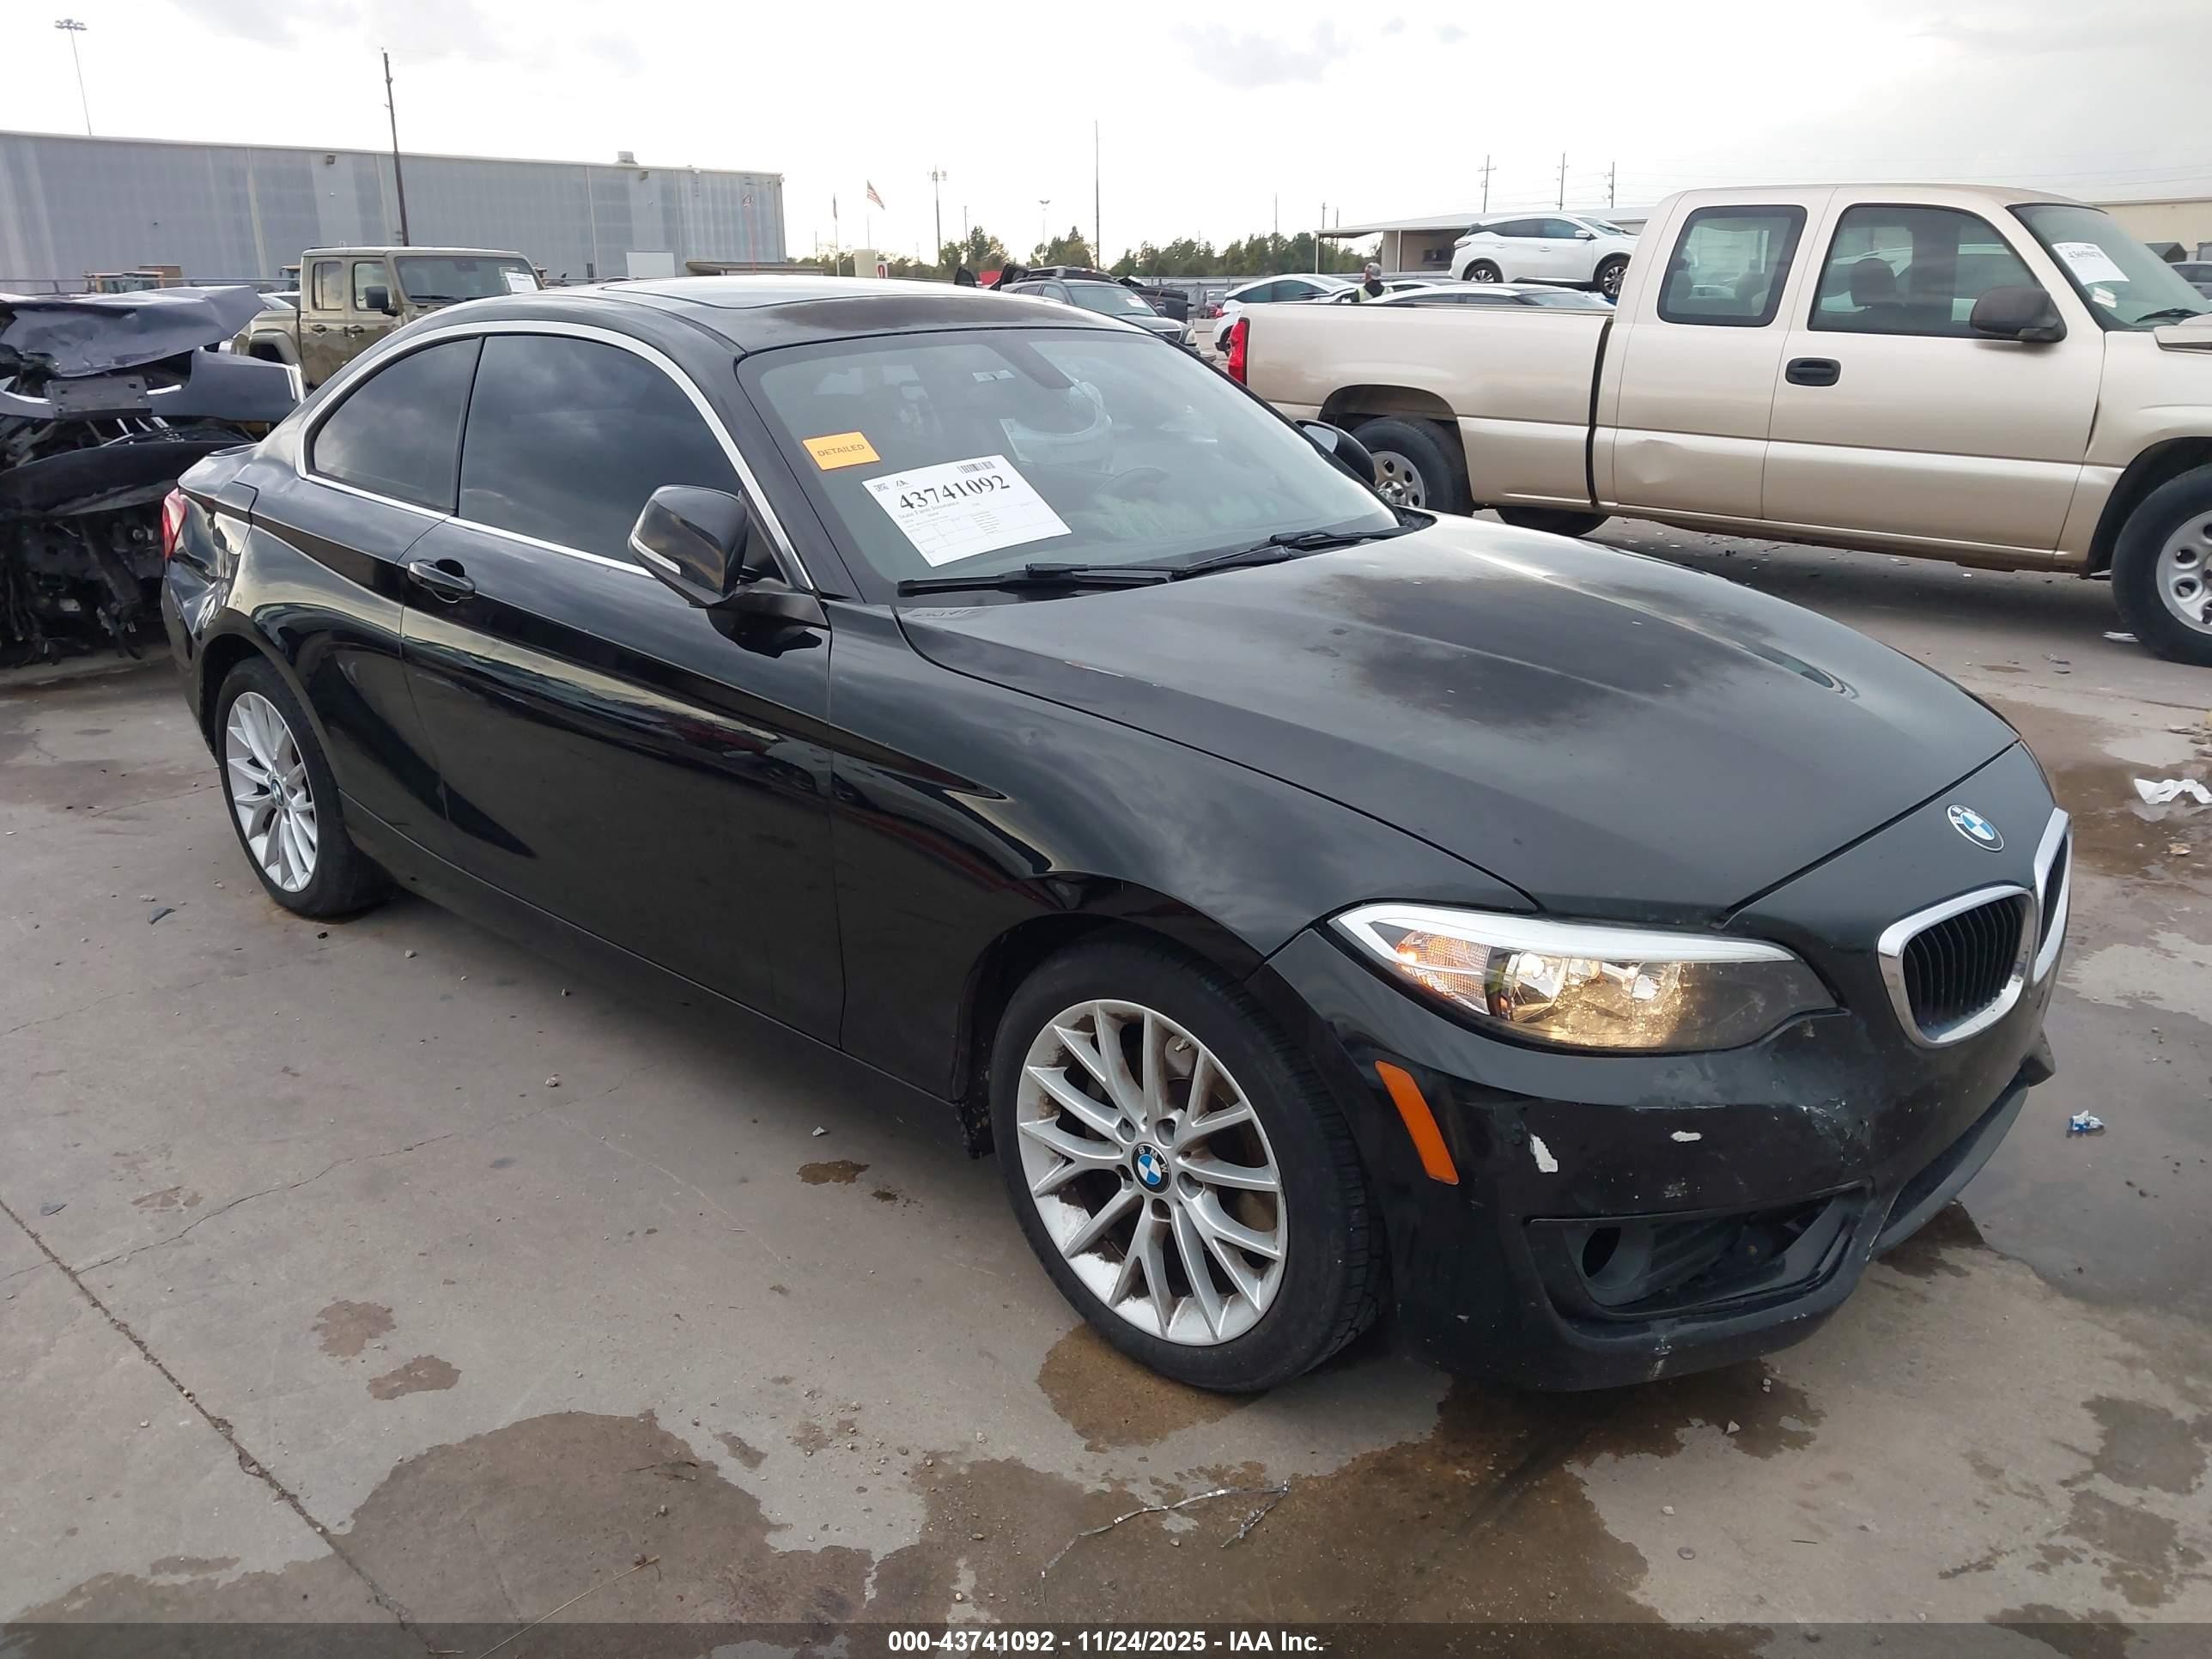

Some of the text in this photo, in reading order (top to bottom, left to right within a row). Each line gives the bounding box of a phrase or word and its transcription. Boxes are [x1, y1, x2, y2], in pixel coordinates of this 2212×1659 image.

[817, 444, 865, 457] DETAILED
[900, 475, 1010, 509] 43741092
[1138, 1146, 1169, 1173] BMW
